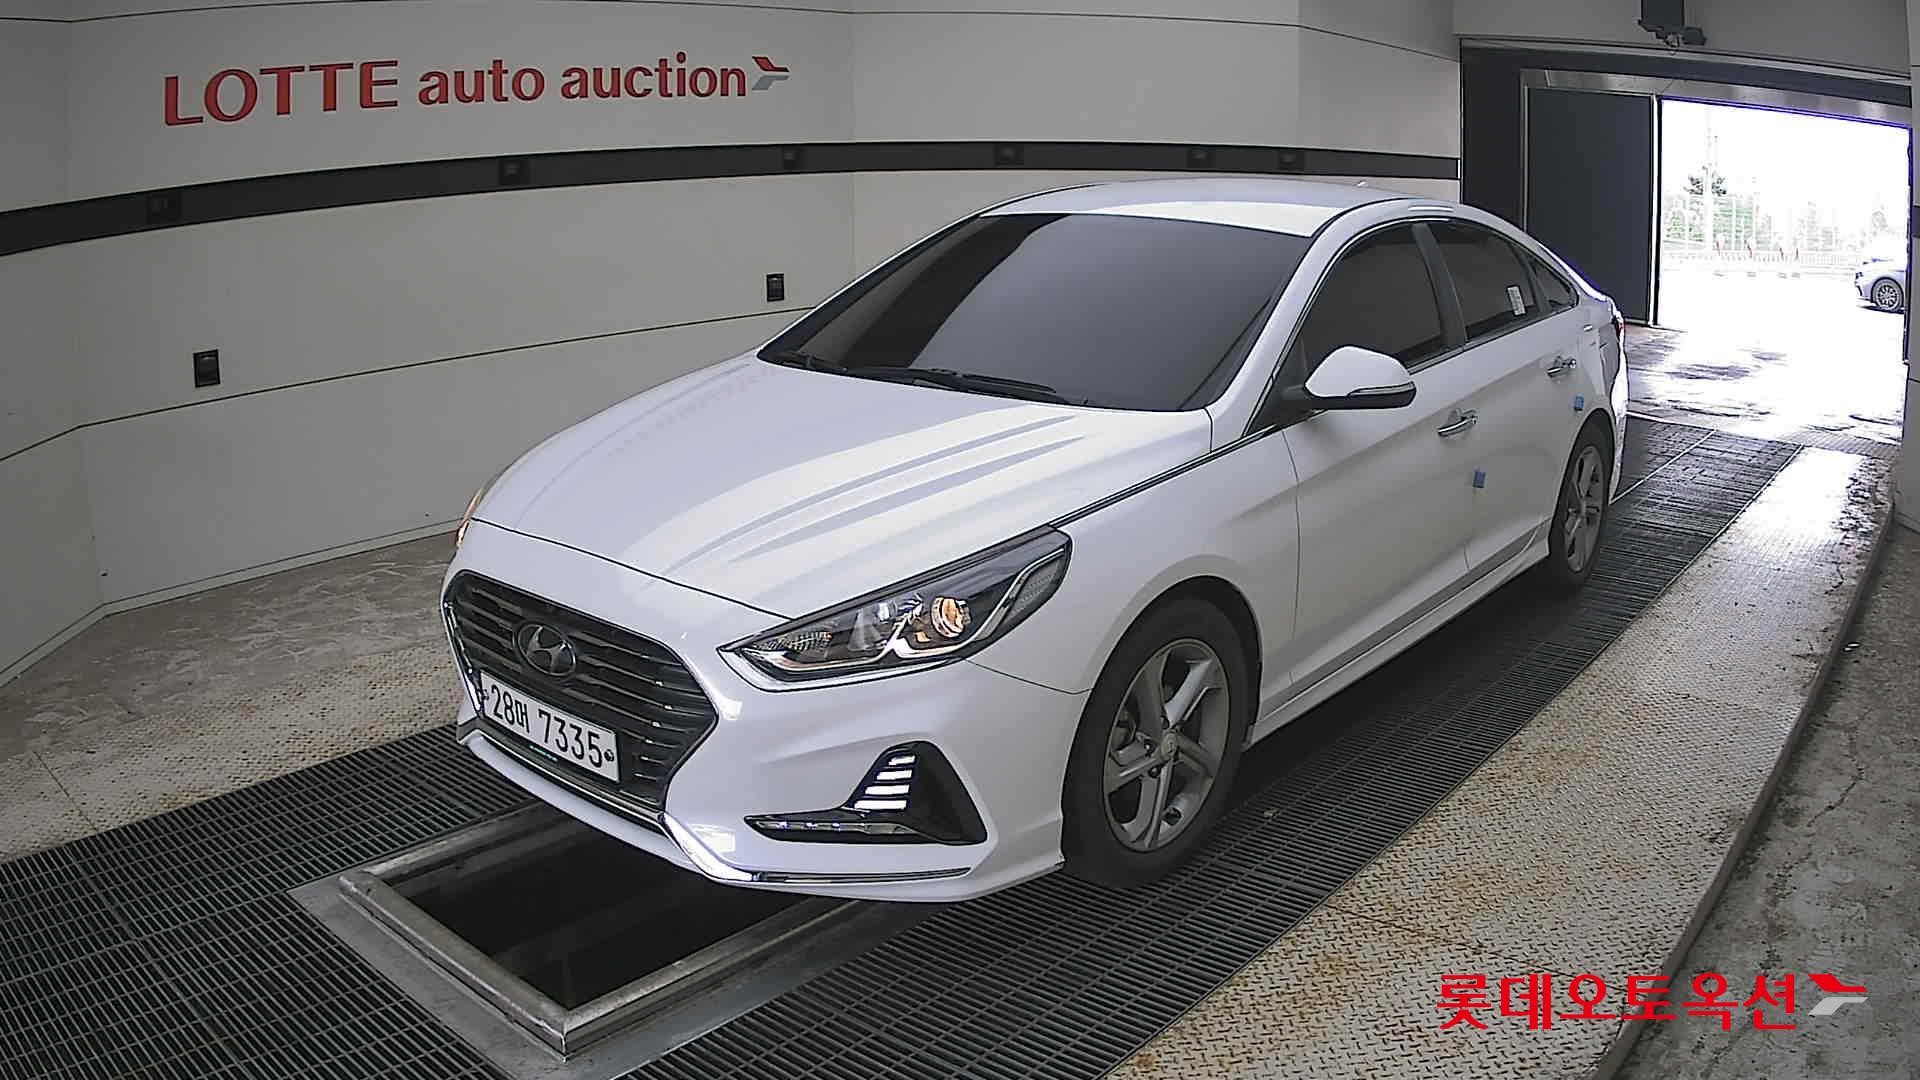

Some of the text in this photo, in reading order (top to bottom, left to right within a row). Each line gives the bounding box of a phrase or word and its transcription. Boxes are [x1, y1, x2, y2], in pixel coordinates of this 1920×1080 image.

[164, 52, 747, 126] LOTTE auto auction
[491, 684, 603, 768] 28머 7335
